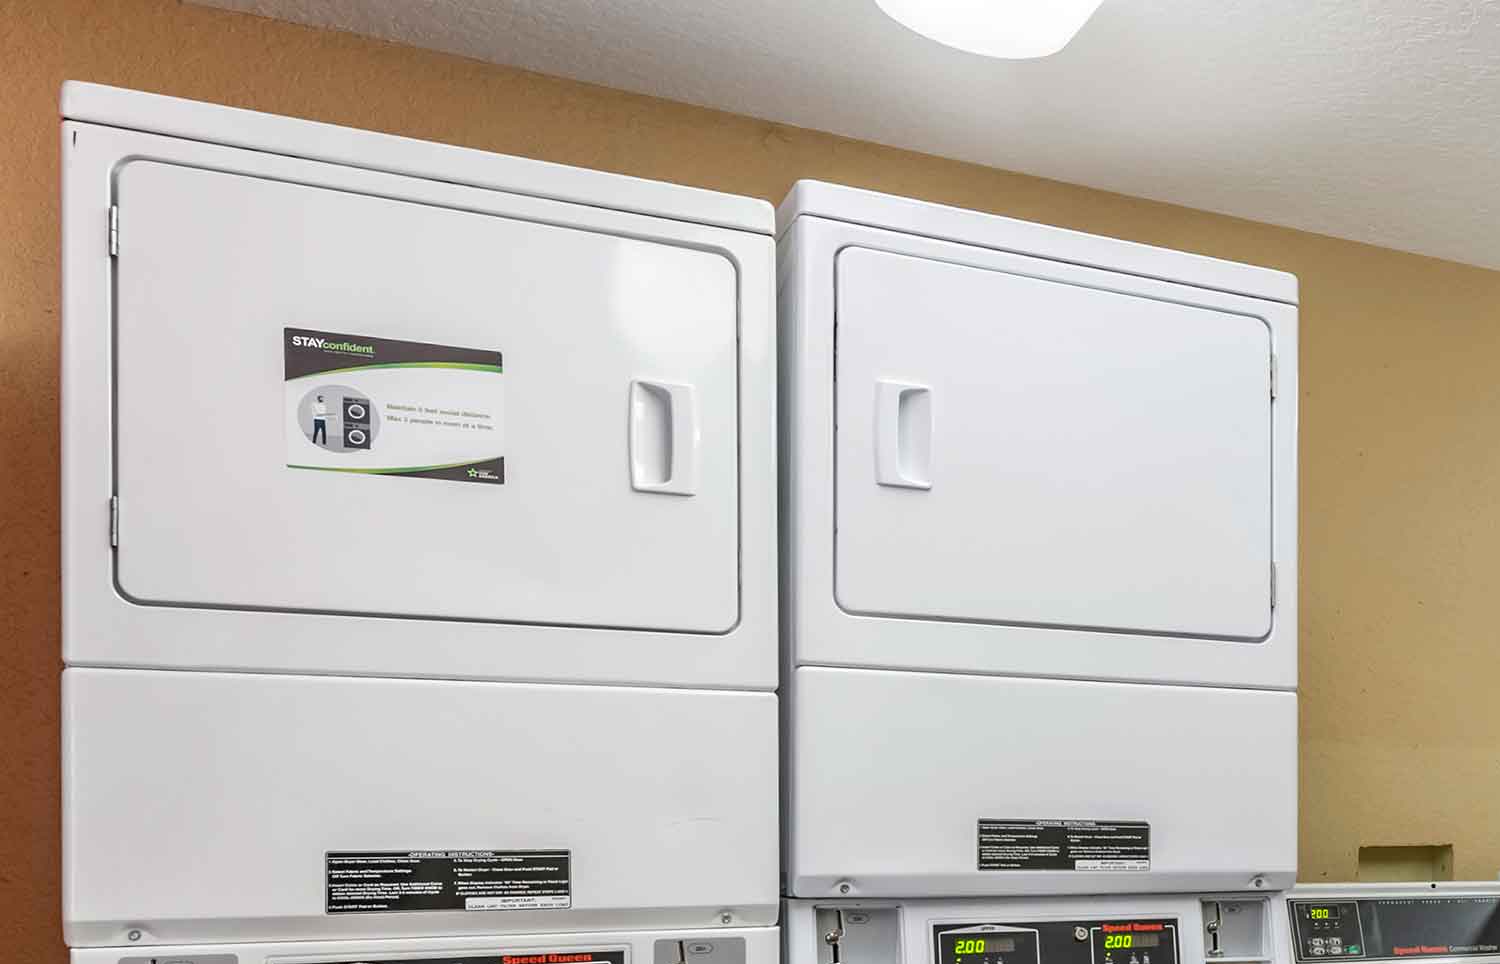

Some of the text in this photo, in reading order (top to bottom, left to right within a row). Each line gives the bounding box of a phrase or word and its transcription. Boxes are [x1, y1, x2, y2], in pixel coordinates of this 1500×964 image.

[955, 940, 985, 954] 2.00
[1105, 935, 1132, 949] 2.00
[502, 953, 593, 964] Speed Queen
